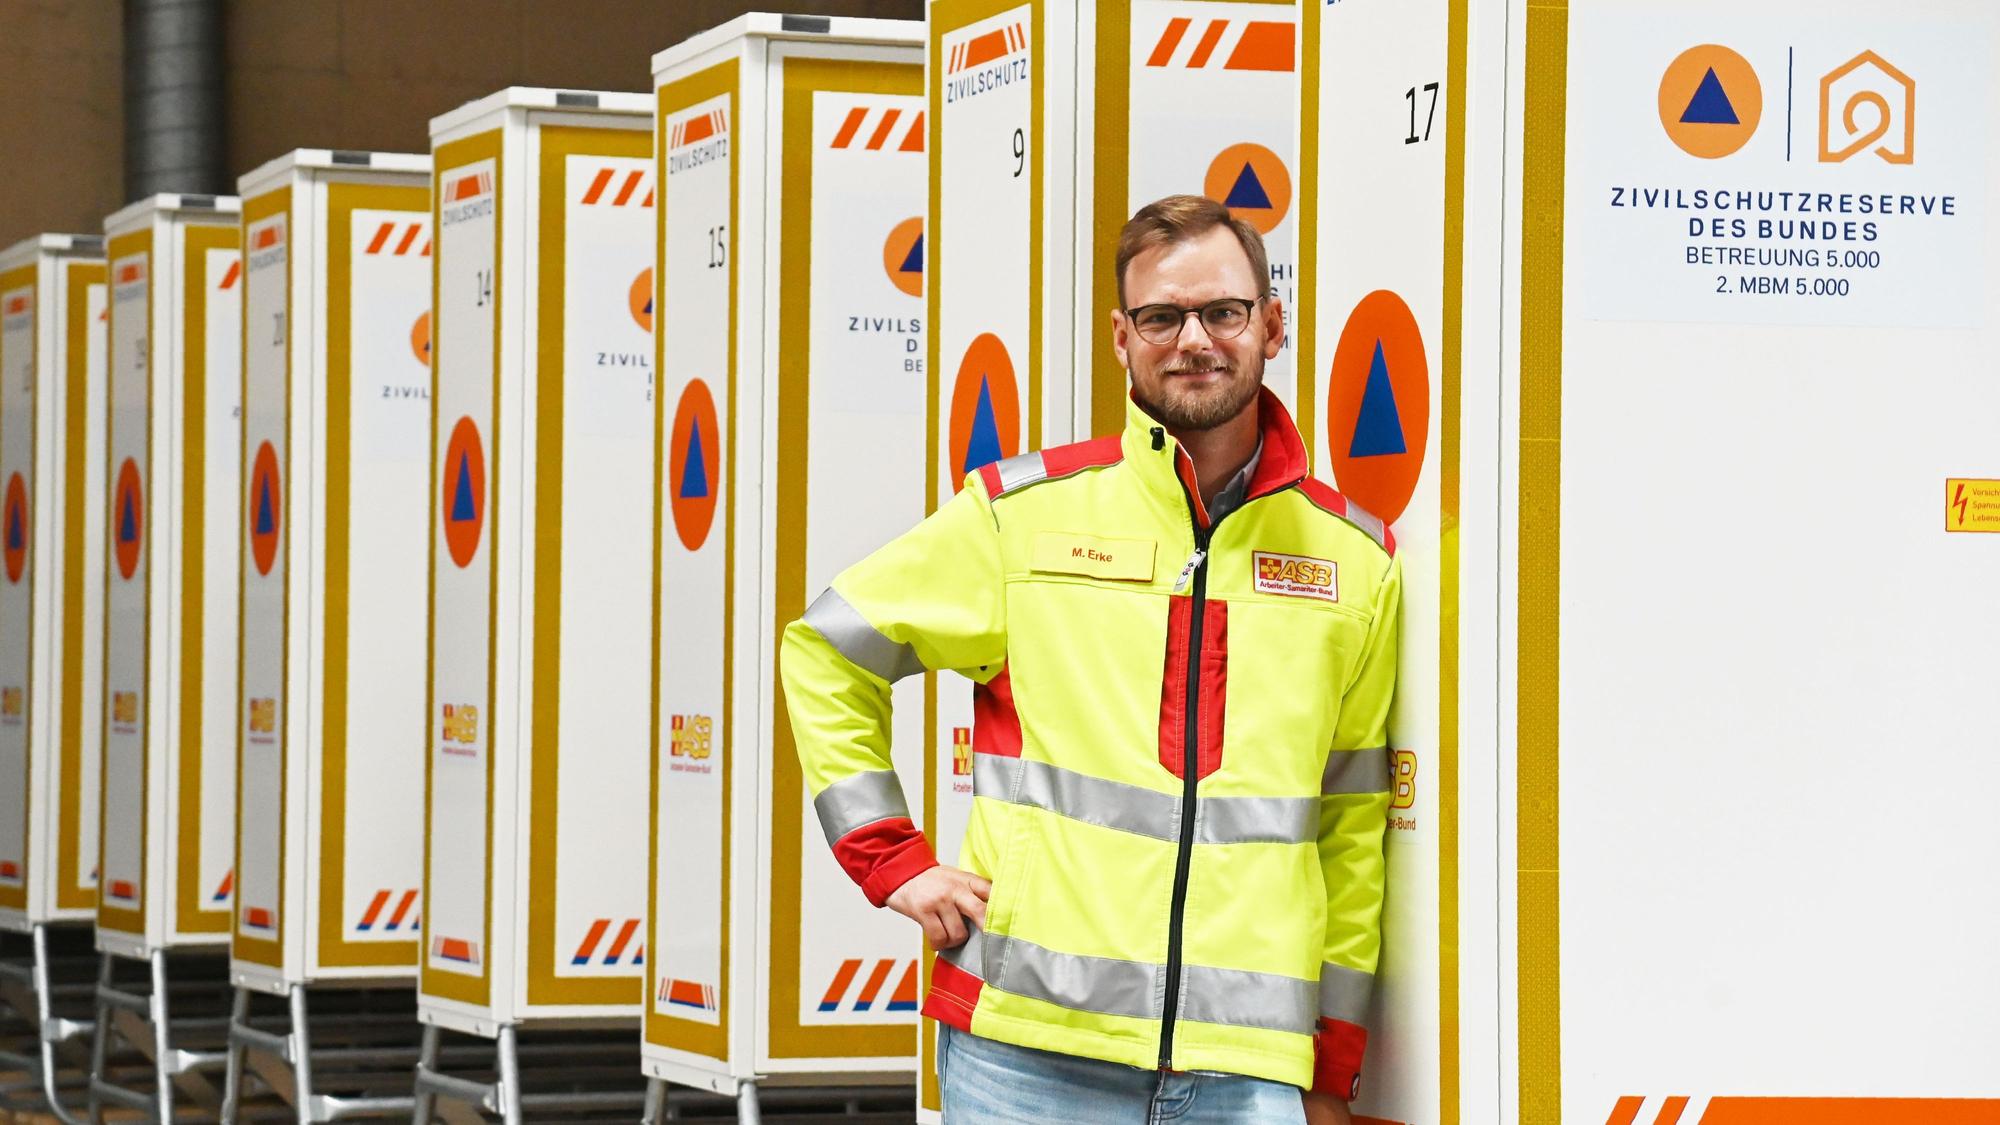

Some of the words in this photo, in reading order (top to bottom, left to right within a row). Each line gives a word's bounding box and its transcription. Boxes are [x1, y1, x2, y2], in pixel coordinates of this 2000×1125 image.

[947, 58, 1026, 103] ZIVILSCHUTZ
[1404, 81, 1439, 145] 17
[1012, 127, 1025, 178] 9
[1611, 187, 1956, 216] ZIVILSCHUTZRESERVE
[1689, 217, 1747, 238] DES
[1758, 220, 1879, 242] BUNDES
[709, 225, 726, 268] 15
[1686, 246, 1819, 267] BETREUUNG
[1826, 250, 1881, 268] 5.000
[477, 269, 491, 307] 14
[1715, 275, 1733, 294] 2.
[1739, 277, 1789, 295] MBM
[1796, 278, 1850, 297] 5.000
[848, 316, 921, 333] ZIVILS
[597, 351, 649, 368] ZIVIL
[1071, 547, 1086, 558] M.
[1087, 549, 1113, 563] Erke
[1276, 559, 1333, 587] ASB
[678, 713, 713, 760] ASB
